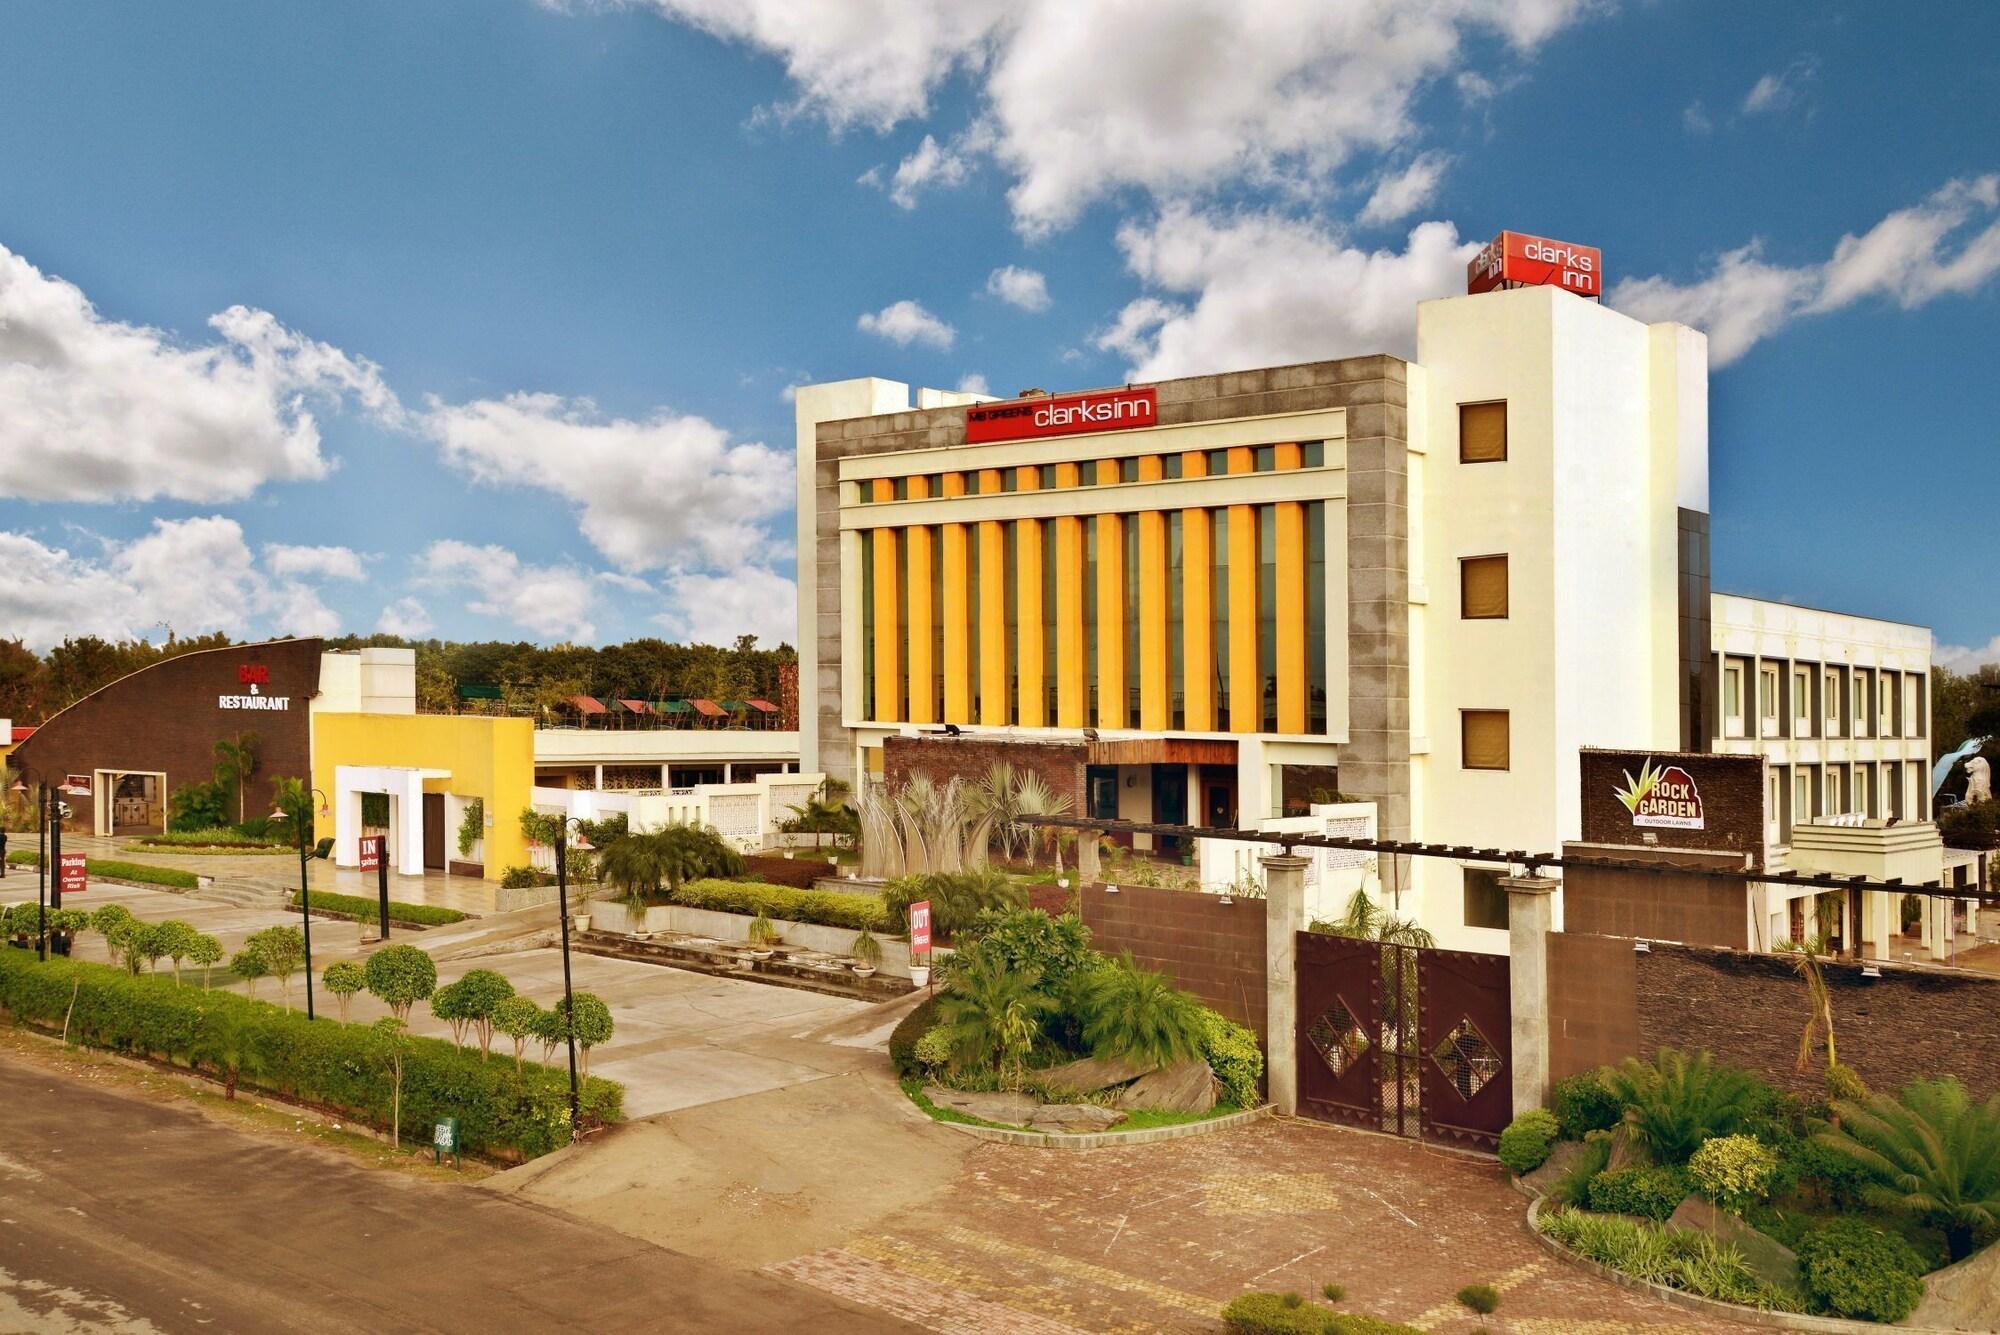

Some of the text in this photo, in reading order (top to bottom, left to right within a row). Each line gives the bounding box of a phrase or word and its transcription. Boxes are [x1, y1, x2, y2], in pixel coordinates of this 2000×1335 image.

[1525, 240, 1592, 272] clarks
[1563, 266, 1592, 290] inn
[989, 406, 1033, 420] GREENS
[239, 664, 270, 684] BAR
[250, 683, 259, 695] &
[219, 695, 290, 711] RESTAURANT
[1651, 781, 1690, 800] ROCK
[1639, 800, 1697, 817] GARDEN
[362, 839, 377, 855] IN
[61, 857, 86, 867] Parking
[913, 908, 929, 930] OUT
